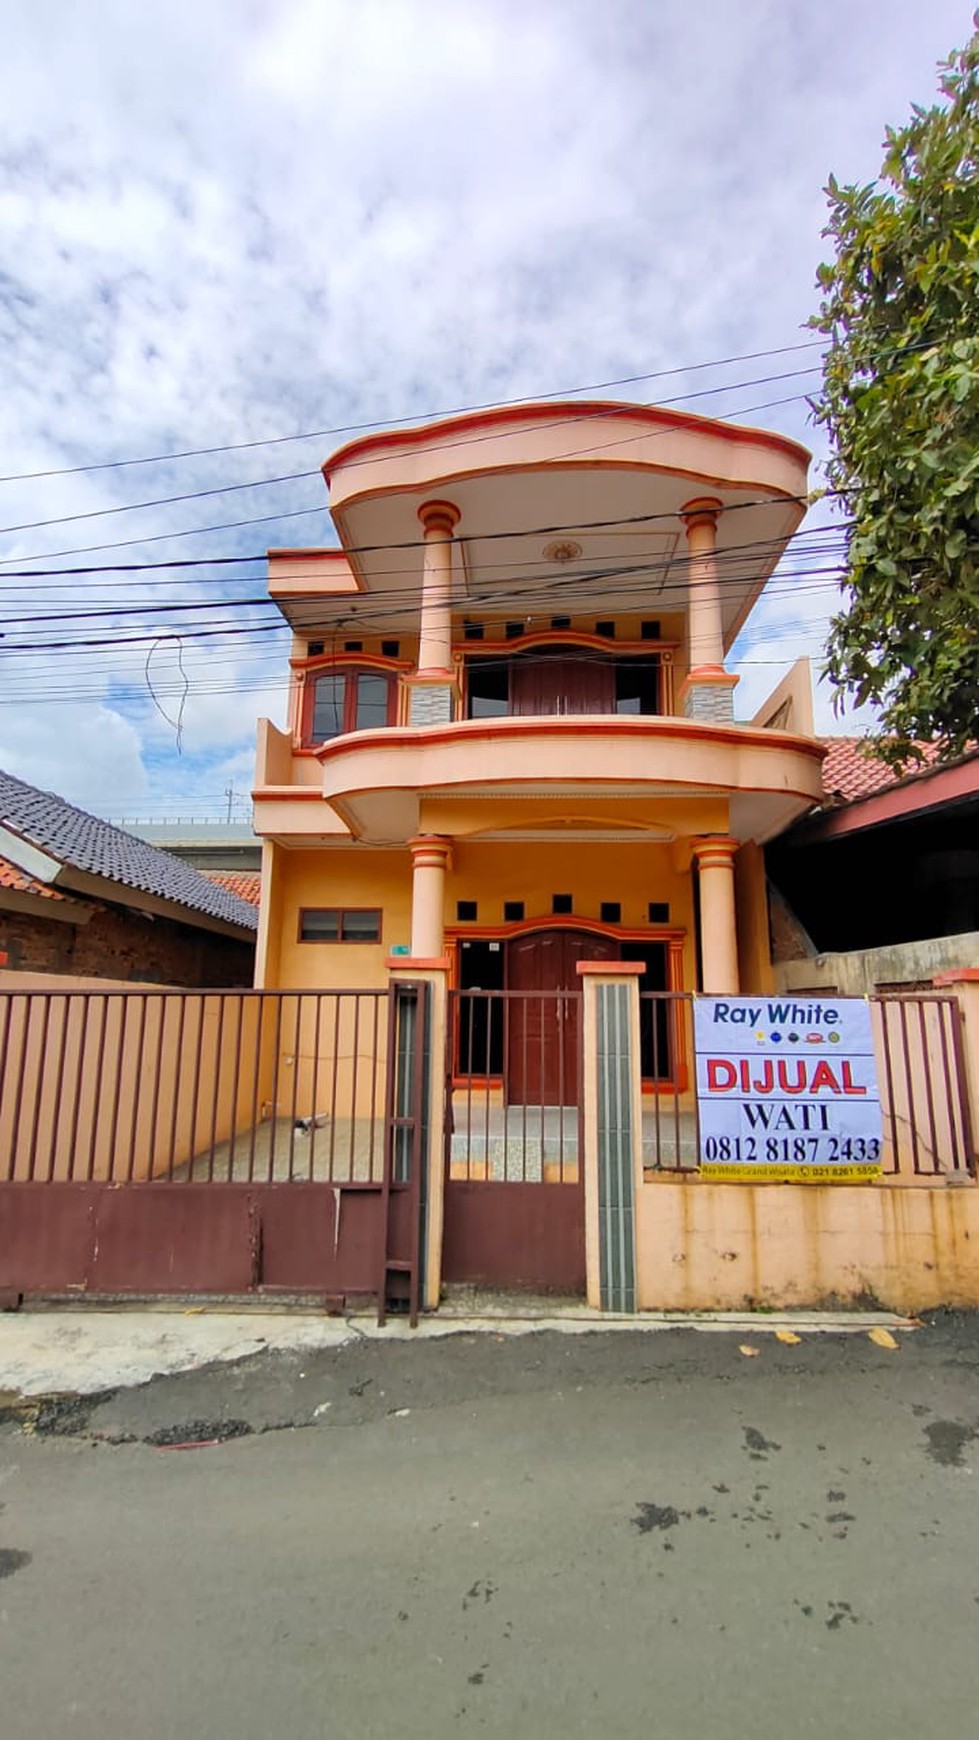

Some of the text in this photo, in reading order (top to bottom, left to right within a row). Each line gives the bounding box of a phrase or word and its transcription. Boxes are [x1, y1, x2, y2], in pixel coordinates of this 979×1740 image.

[713, 1003, 762, 1027] Ray
[707, 1059, 867, 1095] DIJUAL
[742, 1103, 832, 1131] WATI
[705, 1136, 880, 1162] 0812 8187 2433
[813, 1167, 829, 1176] 021
